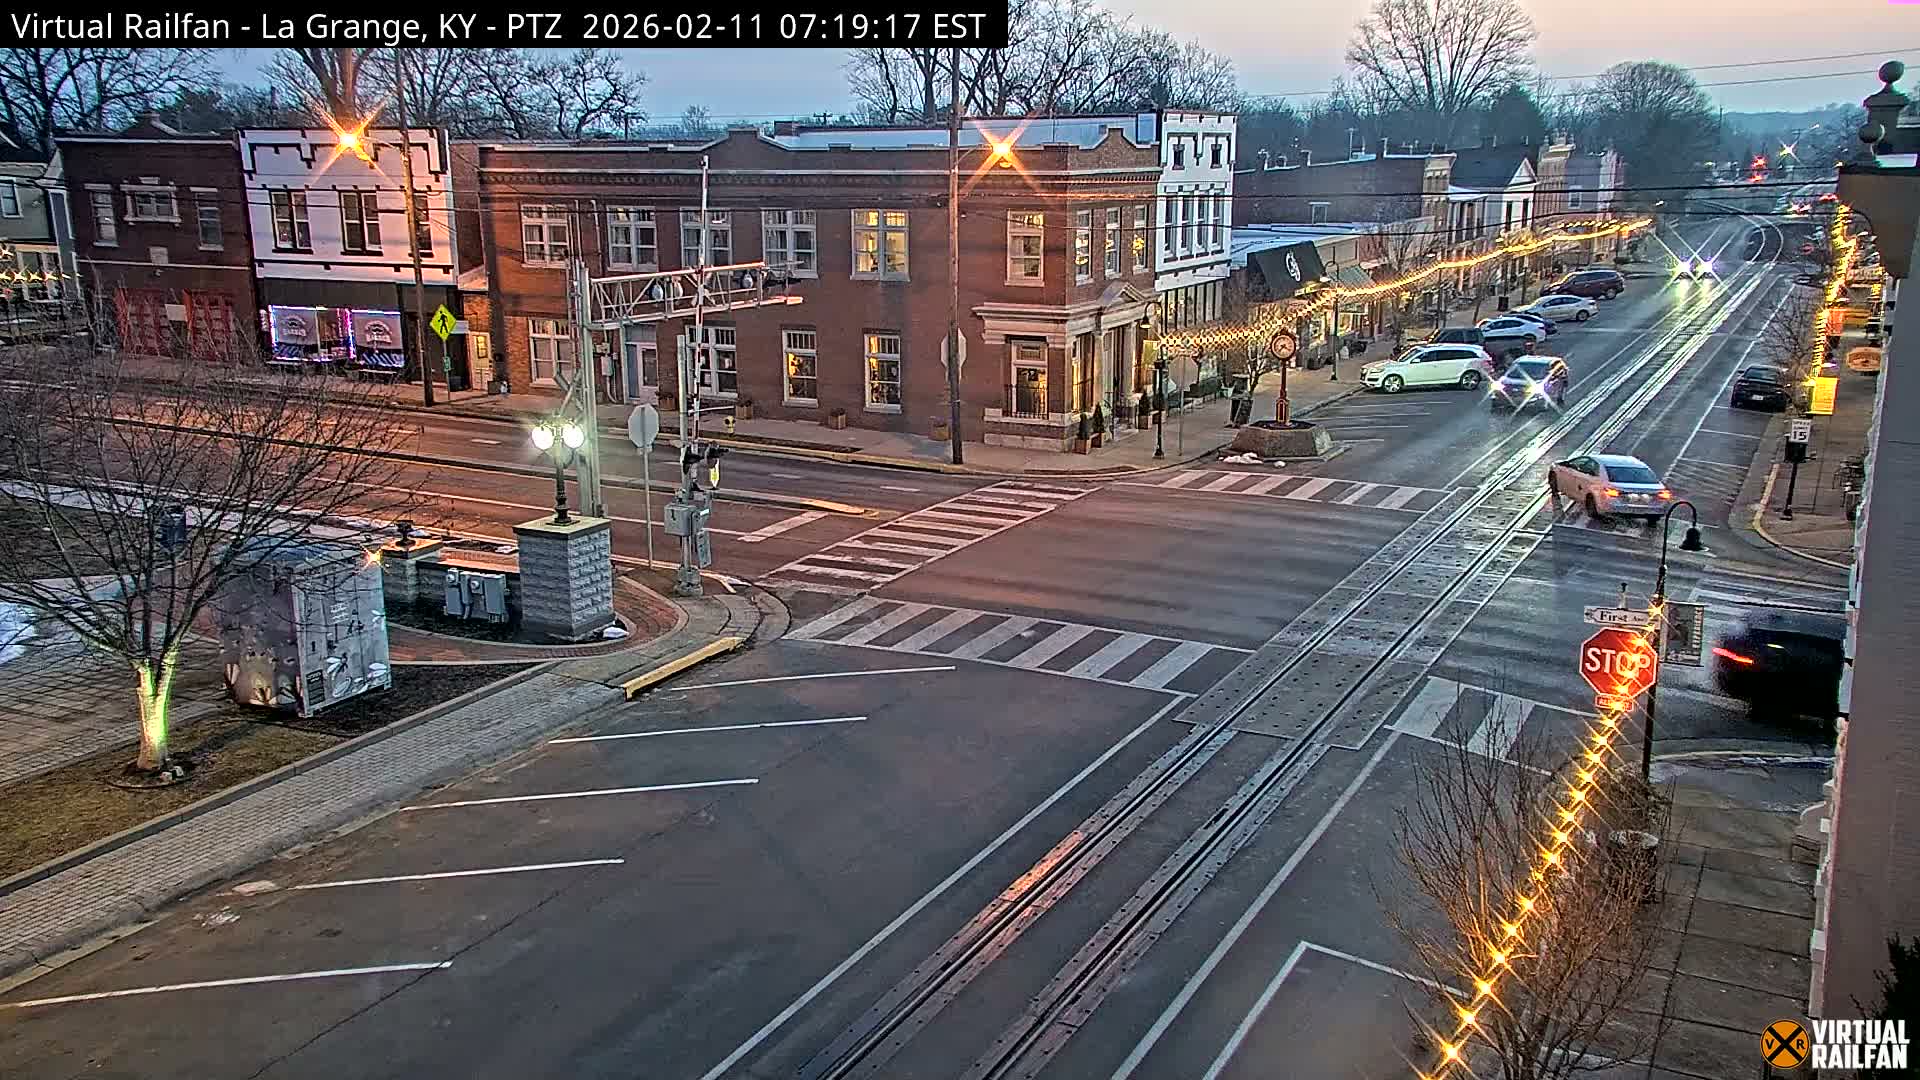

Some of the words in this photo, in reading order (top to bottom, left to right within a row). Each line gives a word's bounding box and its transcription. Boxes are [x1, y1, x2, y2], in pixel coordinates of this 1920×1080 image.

[1793, 431, 1807, 441] 15
[1600, 610, 1628, 622] First
[1585, 647, 1651, 678] STOP
